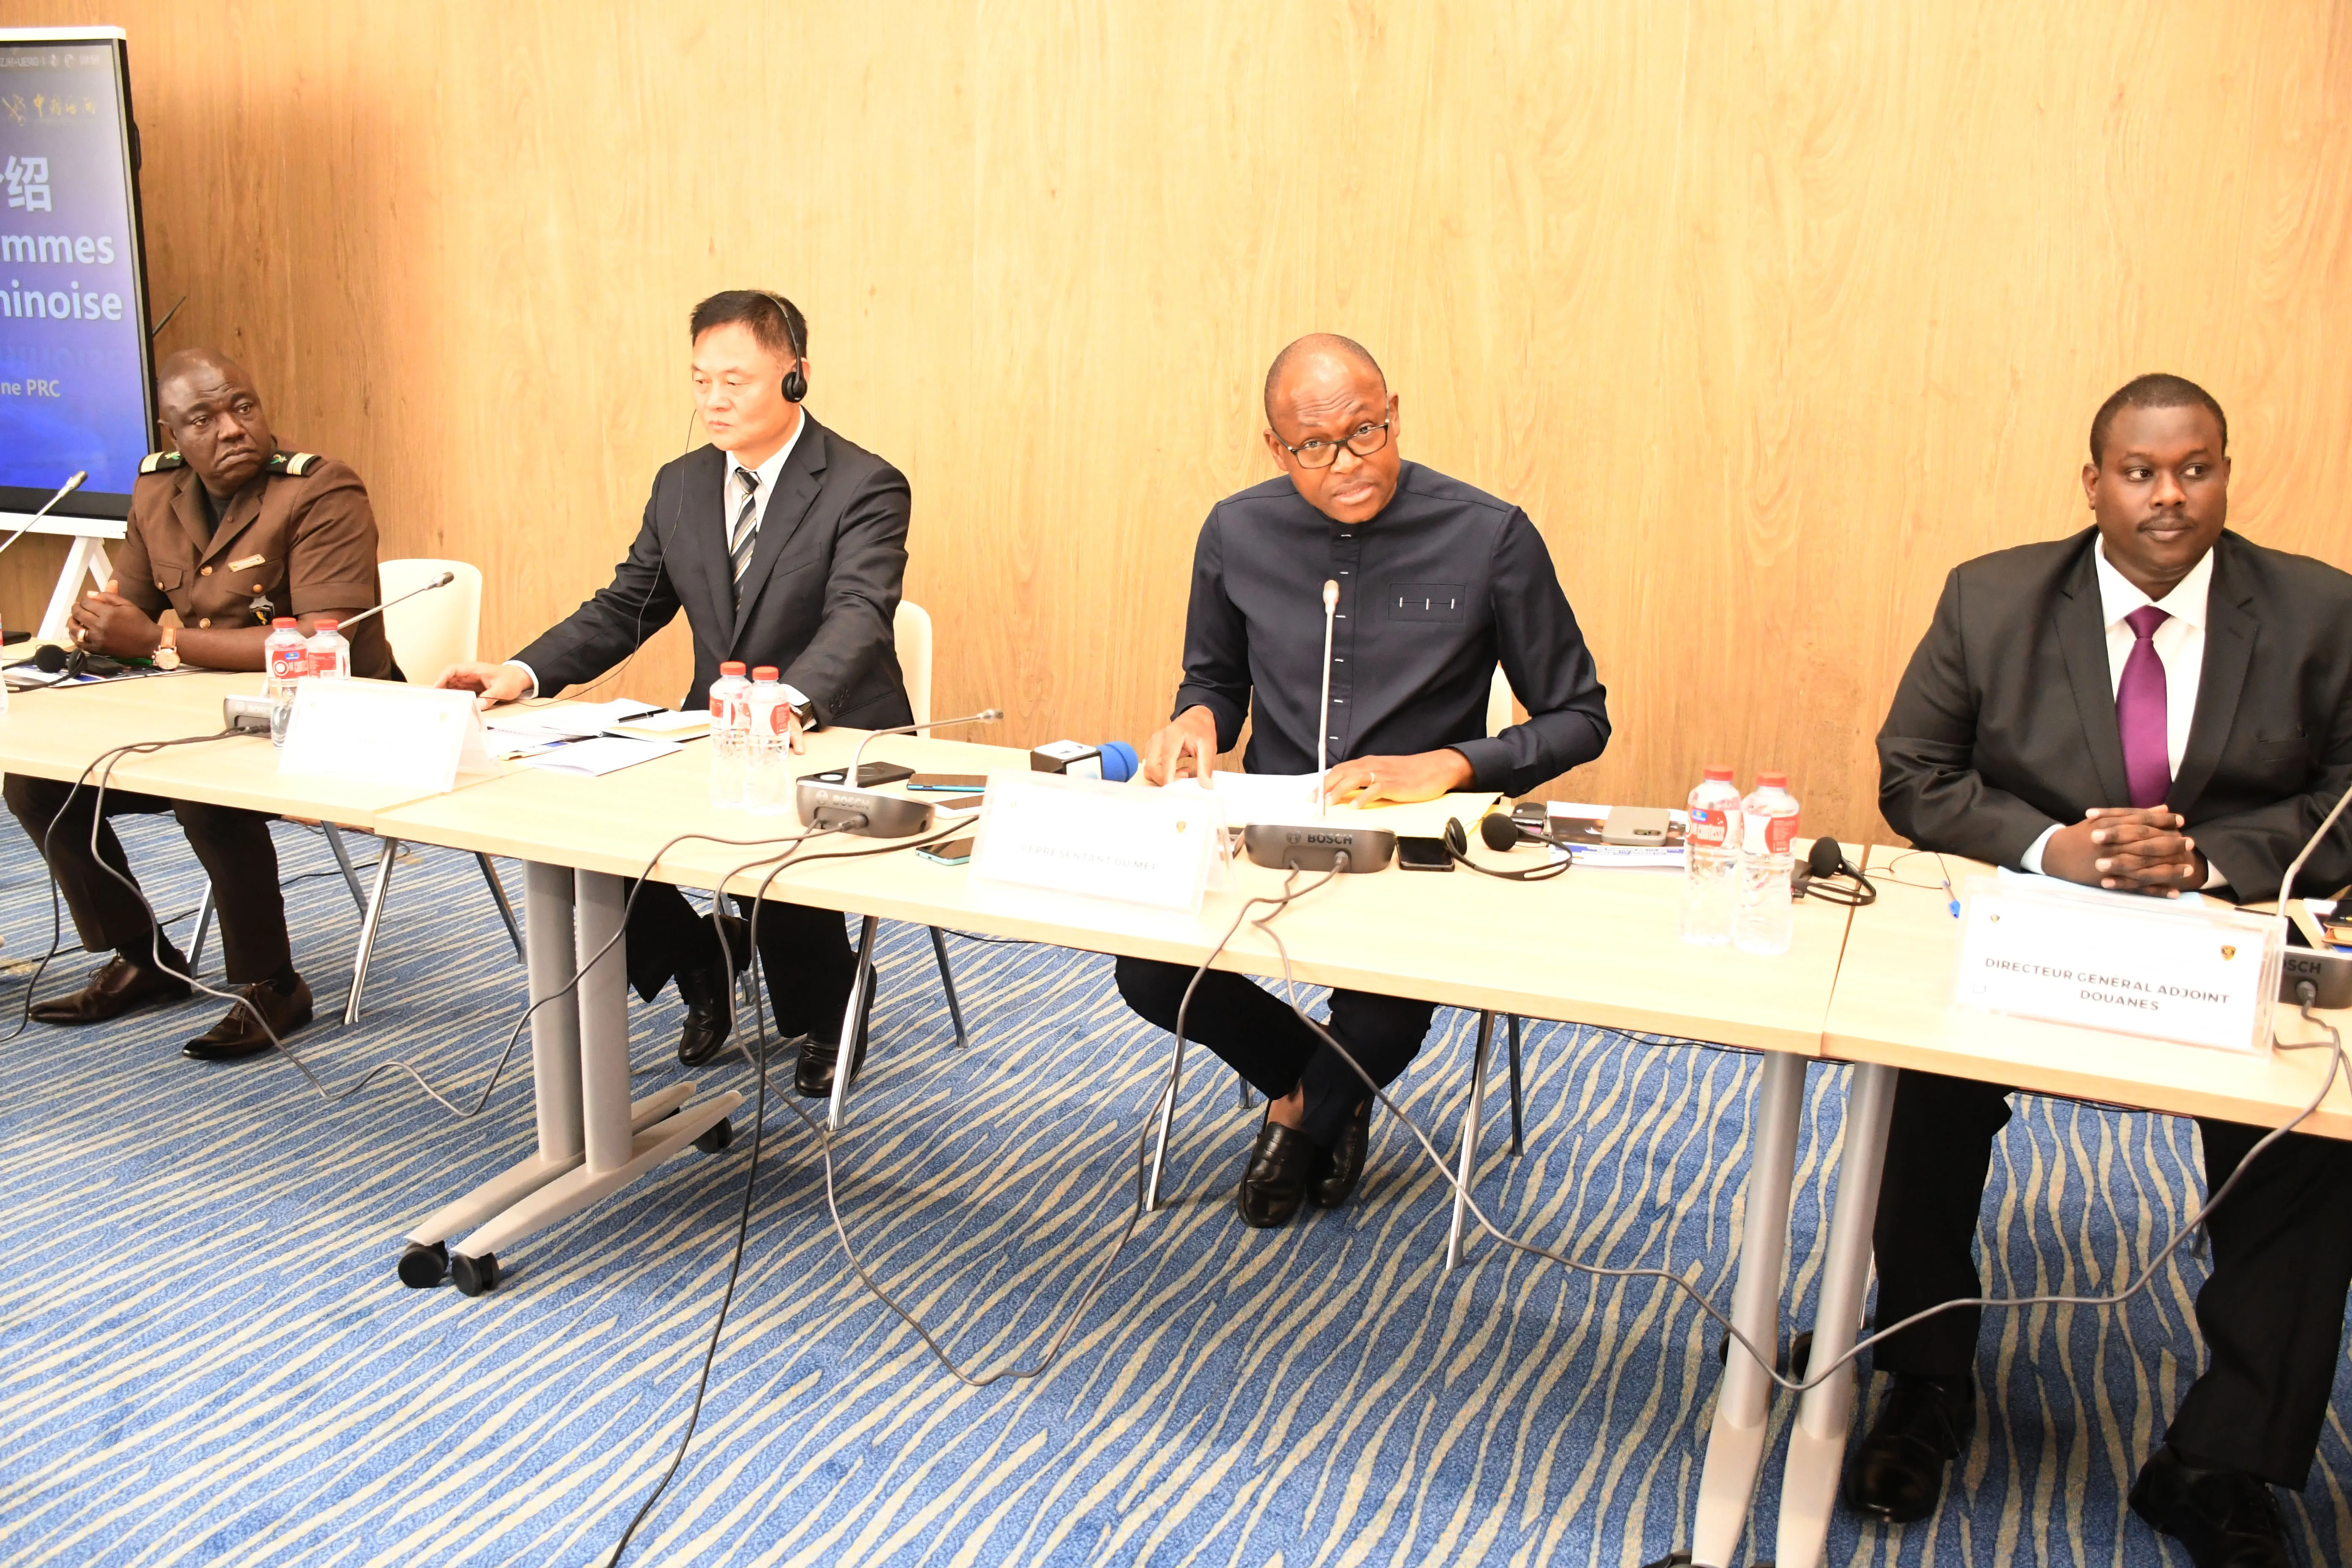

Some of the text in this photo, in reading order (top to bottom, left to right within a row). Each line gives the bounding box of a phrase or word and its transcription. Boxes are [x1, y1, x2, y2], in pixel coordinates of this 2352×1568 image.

[0, 155, 52, 212] 绍
[1, 235, 115, 264] mmes
[26, 379, 61, 397] PRC
[833, 795, 870, 810] BOSCH
[1307, 833, 1353, 844] BOSCH
[2283, 958, 2321, 974] SCH
[1985, 958, 2073, 980] DIRECTEUR
[2156, 985, 2230, 1004] ADJOINT
[2080, 990, 2159, 1011] DOUANES
